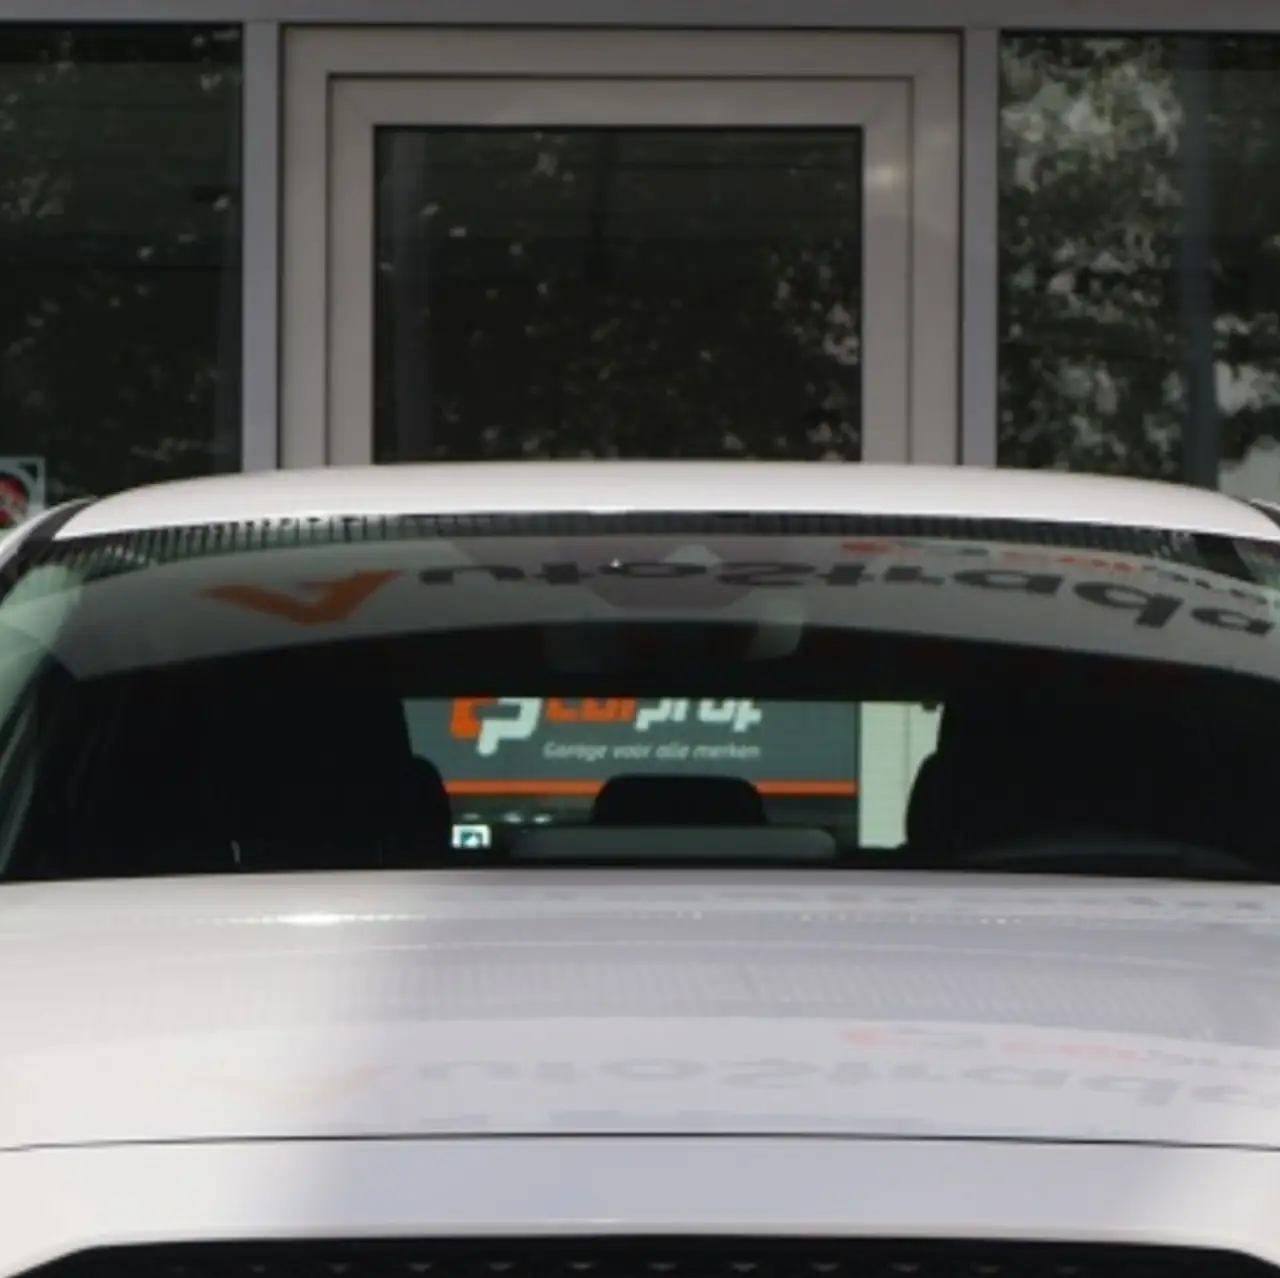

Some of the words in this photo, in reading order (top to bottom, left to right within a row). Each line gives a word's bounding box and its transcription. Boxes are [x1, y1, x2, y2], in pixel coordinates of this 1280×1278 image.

[542, 742, 608, 762] Garage
[612, 743, 650, 760] voor
[656, 741, 690, 760] alle
[693, 741, 761, 760] merken
